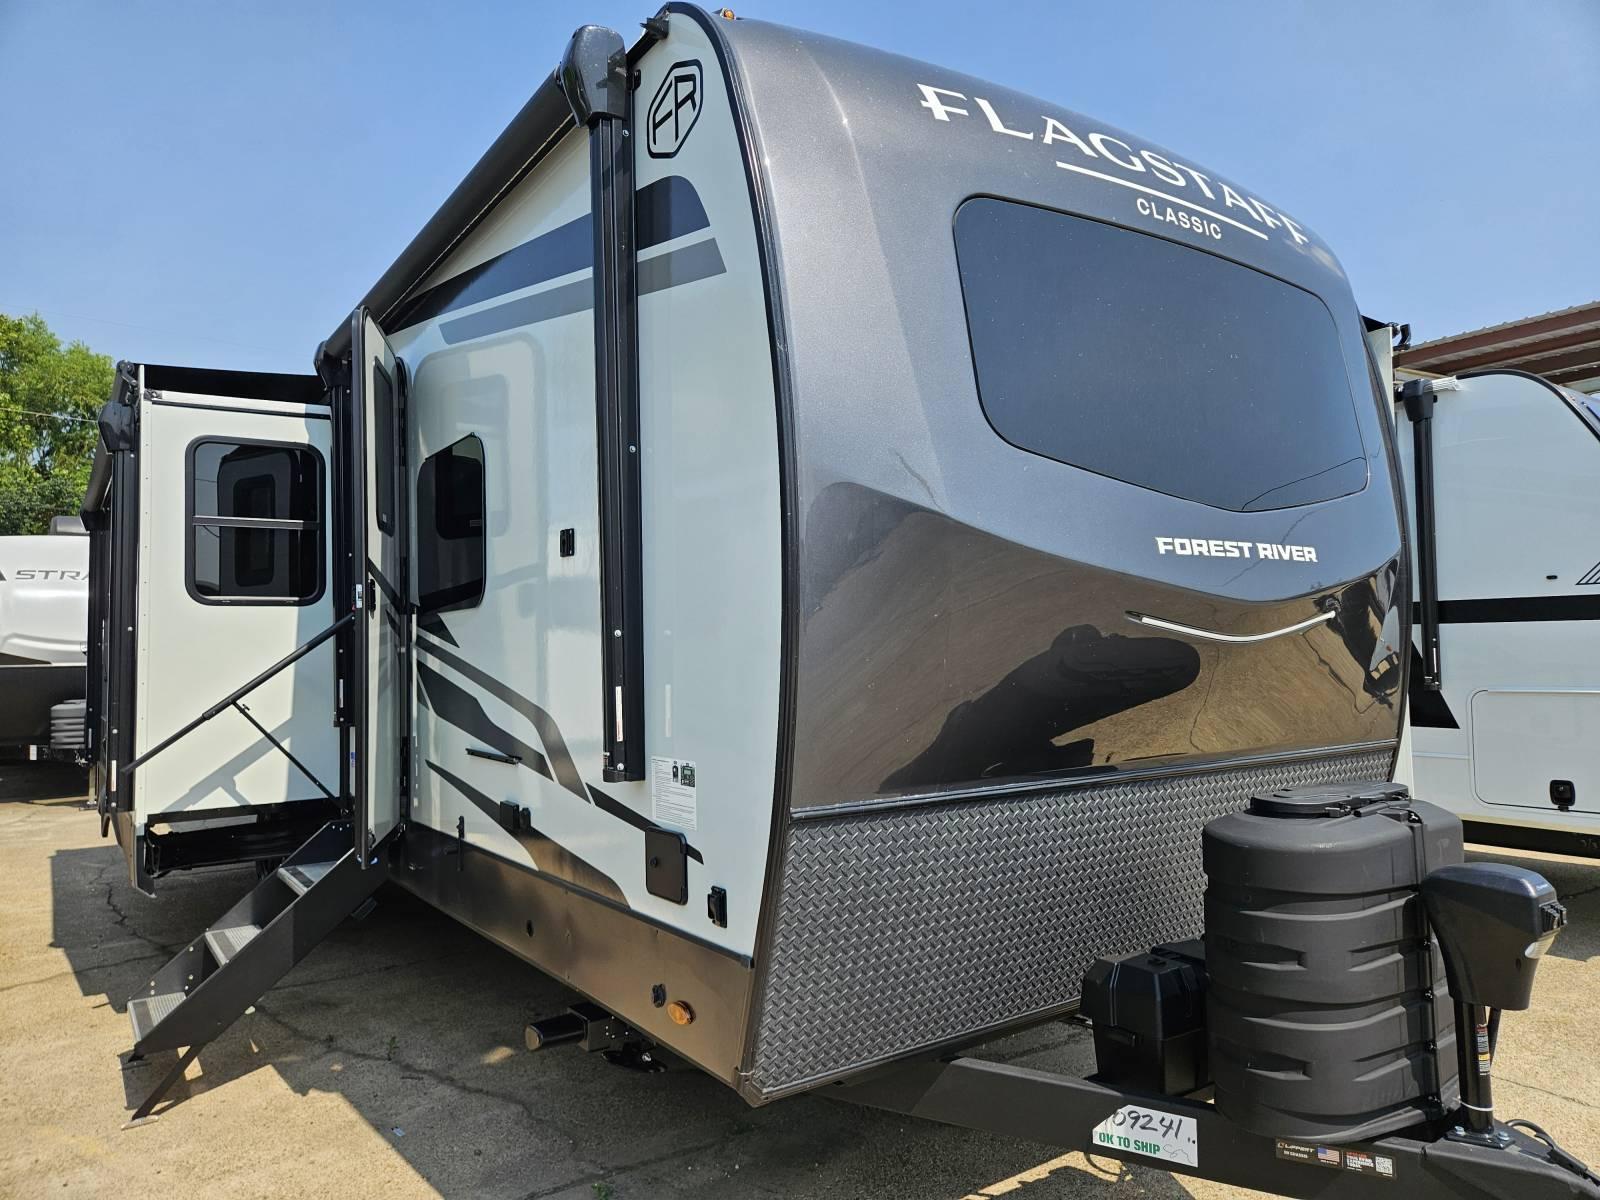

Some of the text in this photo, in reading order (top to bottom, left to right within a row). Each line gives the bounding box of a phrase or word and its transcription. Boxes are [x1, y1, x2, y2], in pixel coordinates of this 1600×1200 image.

[917, 83, 1309, 245] FLAGSTAFF
[1136, 198, 1222, 240] CLASSIC
[1154, 536, 1318, 563] FOREST RIVER
[1098, 1132, 1114, 1145] OK
[1116, 1135, 1131, 1148] TO
[1133, 1139, 1161, 1155] SHIP
